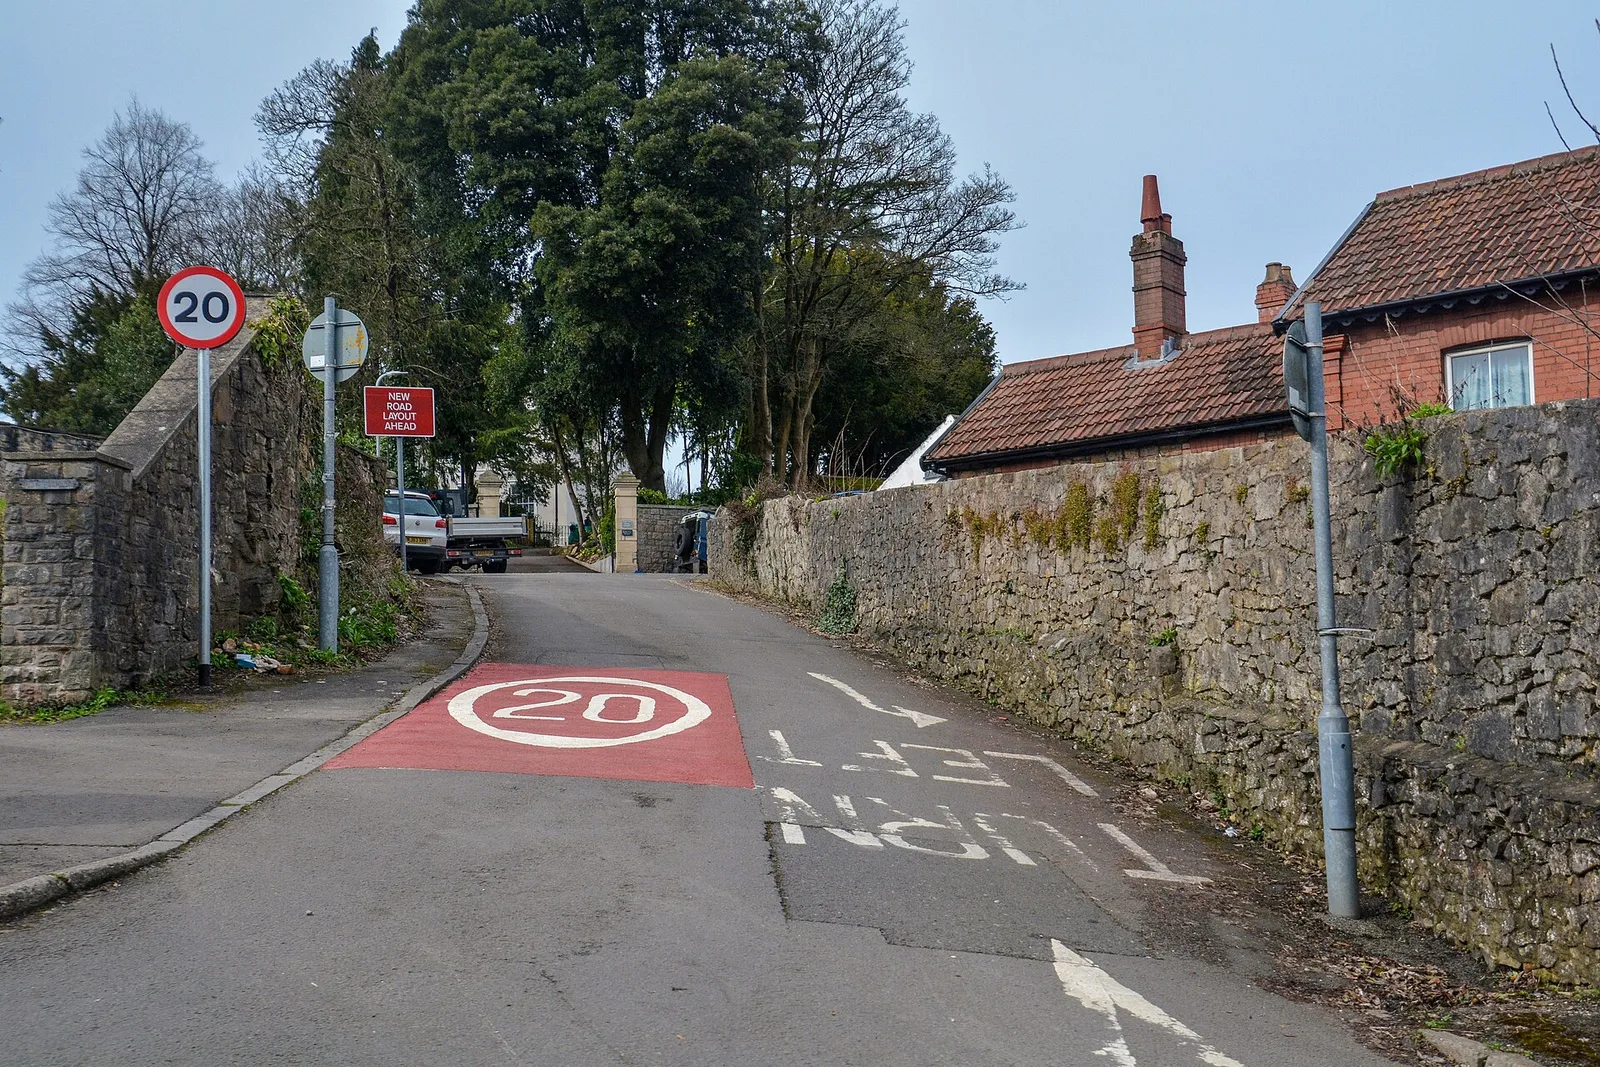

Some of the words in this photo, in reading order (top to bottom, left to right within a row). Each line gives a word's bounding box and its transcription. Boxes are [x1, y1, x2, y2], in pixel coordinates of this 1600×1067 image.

[173, 291, 230, 324] 20
[388, 392, 410, 401] NEW
[386, 402, 412, 411] ROAD
[382, 412, 417, 421] LAYOUT
[384, 422, 417, 431] AHEAD
[492, 688, 656, 724] 20
[757, 729, 1099, 797] LEFT
